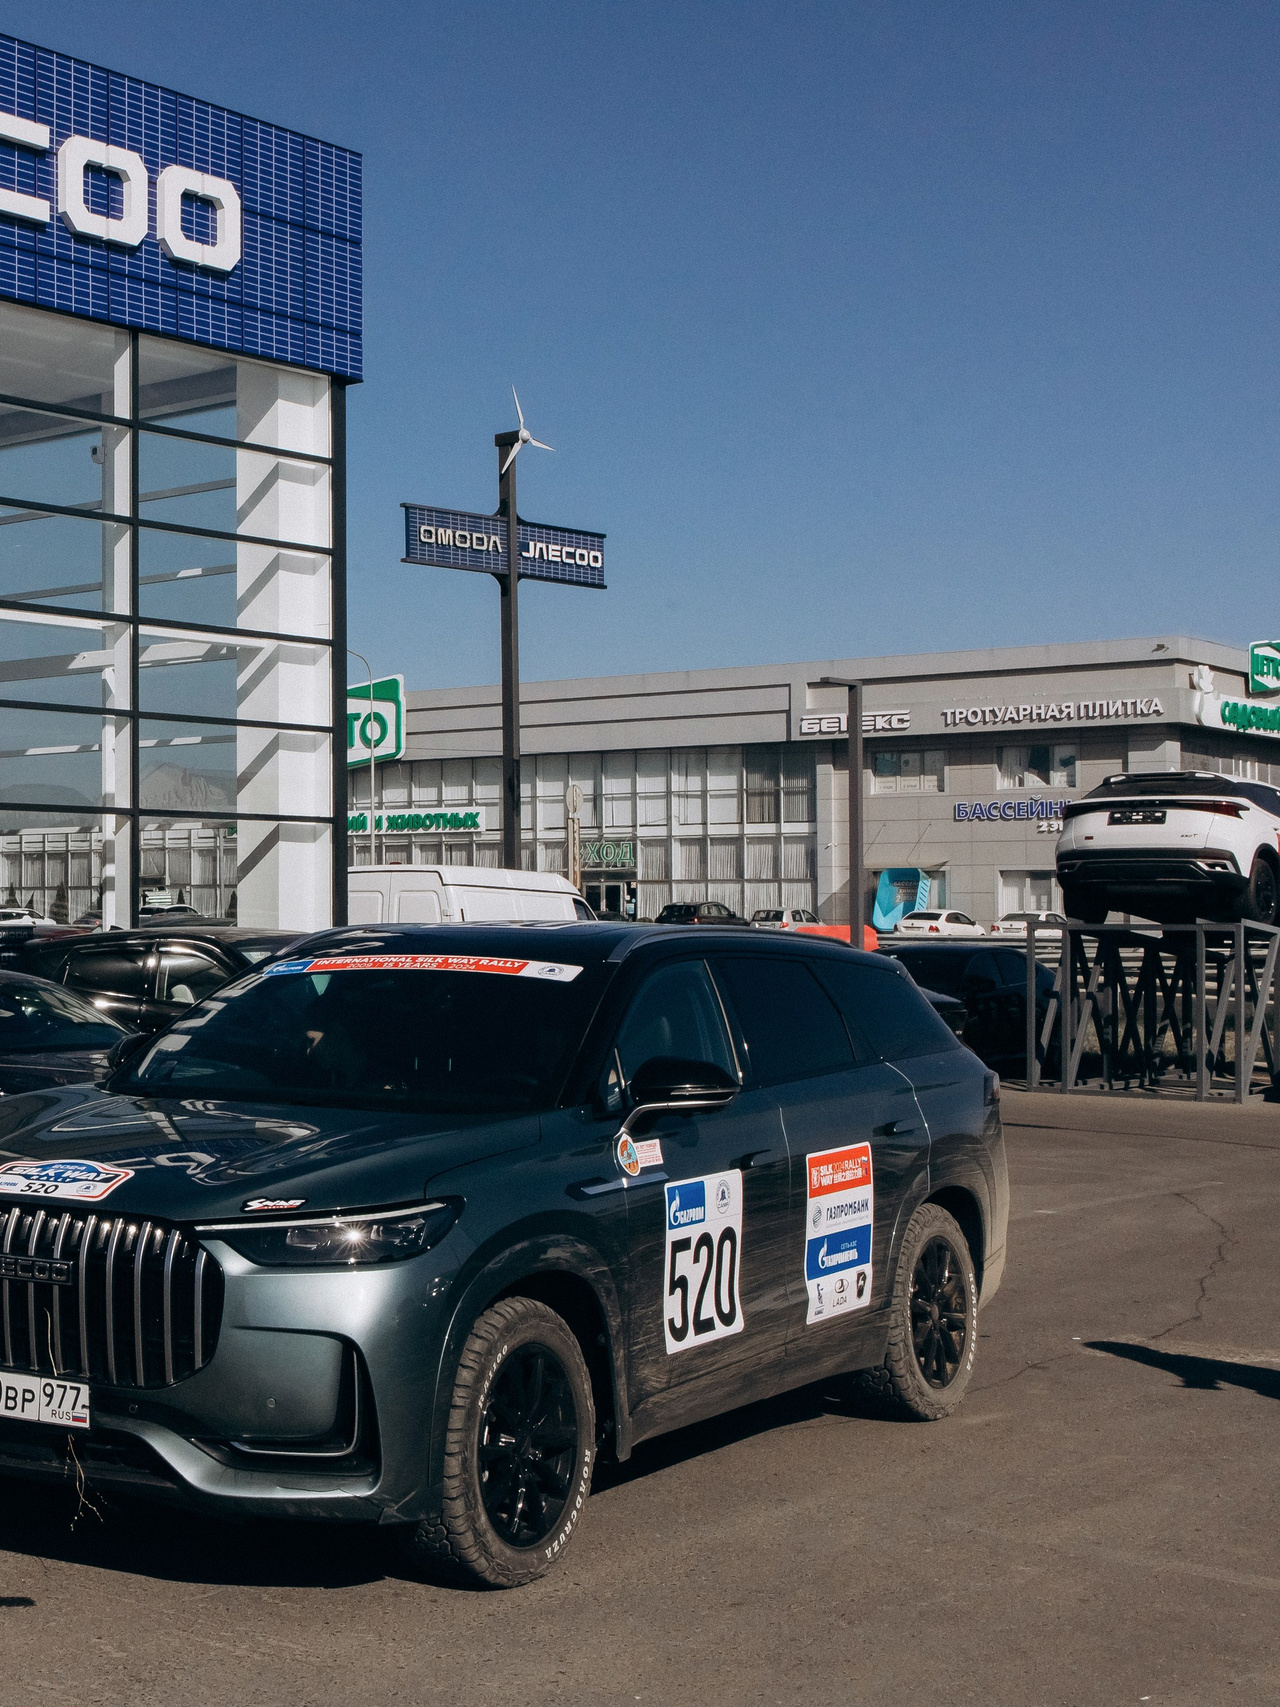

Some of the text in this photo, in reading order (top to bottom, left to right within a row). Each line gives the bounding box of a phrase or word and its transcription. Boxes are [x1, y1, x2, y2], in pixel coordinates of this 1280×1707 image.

[419, 525, 503, 553] OMODA
[521, 541, 602, 568] JAECOO
[942, 697, 1164, 725] ТРОТУАРНАЯ ПЛИТКА
[955, 794, 1072, 820] БАССЕЙН
[317, 956, 523, 968] INTERNATIONAL SILK WAY RALLY
[5, 1166, 116, 1181] SILK WAY
[820, 1163, 833, 1177] SILK
[844, 1157, 862, 1171] RALLY
[20, 1182, 59, 1195] 520
[820, 1174, 833, 1187] WAY
[826, 1198, 869, 1221] ГАЗПРОМБАНК
[668, 1226, 737, 1343] 520
[833, 1295, 847, 1307] LADA
[42, 1382, 81, 1411] 977
[51, 1409, 71, 1421] RUS
[544, 1449, 591, 1560] ROADCRUZA
